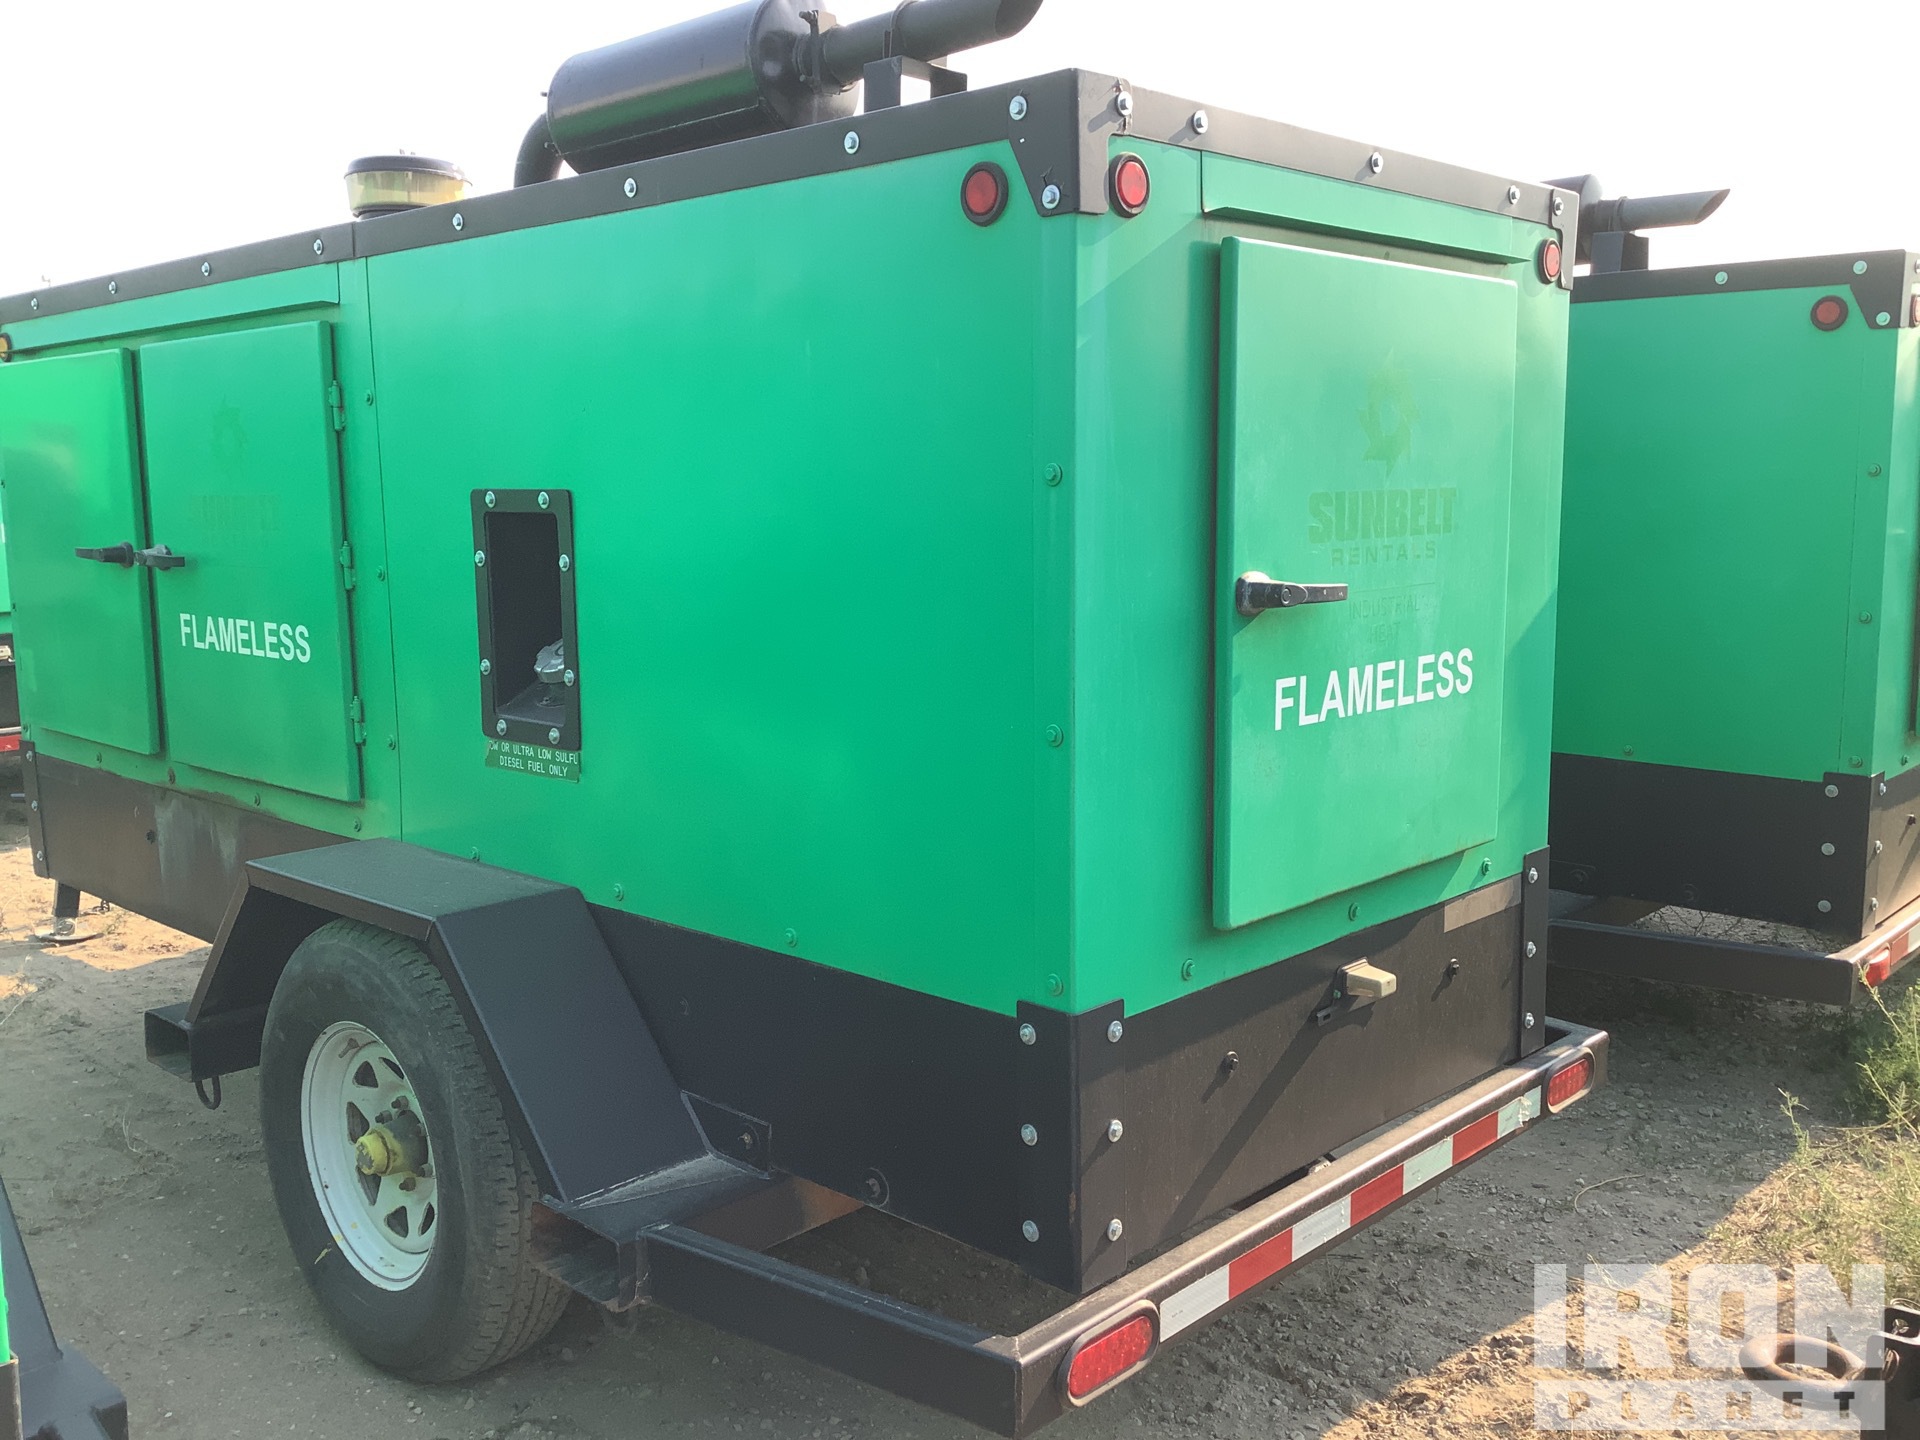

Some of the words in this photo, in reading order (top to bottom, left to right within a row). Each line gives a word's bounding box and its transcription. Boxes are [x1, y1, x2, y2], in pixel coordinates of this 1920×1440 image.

[1308, 487, 1458, 544] SUNBELT
[1330, 541, 1437, 567] RENTALS
[1349, 592, 1421, 619] INDUSTRIAL
[179, 612, 312, 664] FLAMELESS
[1274, 647, 1474, 731] FLAMELESS
[501, 741, 510, 753] OR
[512, 744, 534, 757] ULTRA
[537, 747, 552, 760] LOW
[499, 755, 524, 770] DIESEL
[528, 760, 546, 774] FUEL
[548, 764, 568, 777] ONLY
